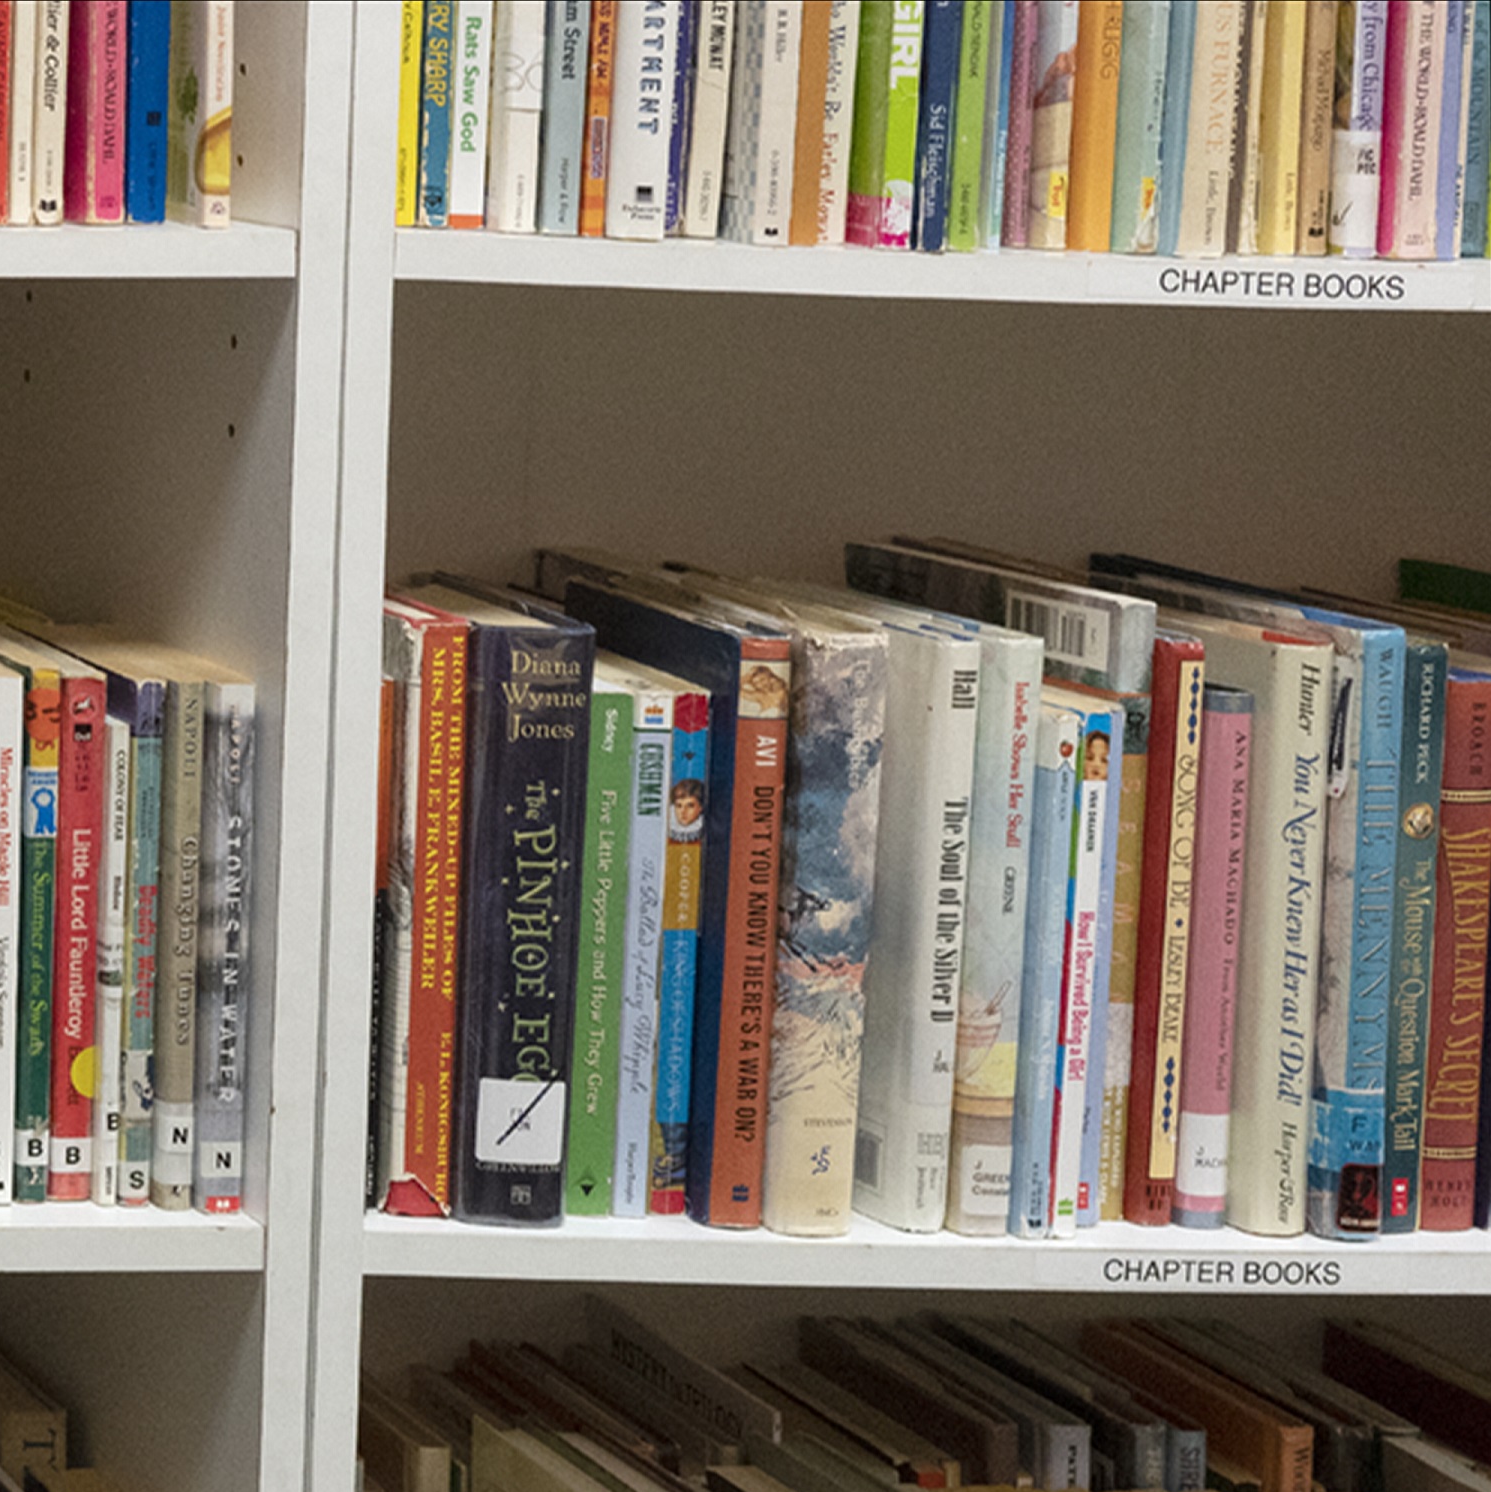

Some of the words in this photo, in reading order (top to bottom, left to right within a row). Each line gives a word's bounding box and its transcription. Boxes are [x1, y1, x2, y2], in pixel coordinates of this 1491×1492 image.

[464, 17, 482, 58] Rats
[462, 66, 480, 109] Saw
[460, 116, 478, 152] God
[1159, 267, 1294, 297] CHAPTER
[1303, 274, 1406, 300] BOOKS
[511, 651, 581, 673] Diana
[502, 684, 586, 706] Wynne
[1297, 663, 1320, 735] Hunter
[183, 699, 197, 778] NAPOLI
[508, 716, 573, 739] Jones
[754, 735, 778, 766] AVI
[637, 743, 665, 815] CUSHMAN
[1290, 753, 1319, 794] You
[749, 786, 775, 839] DON'T
[72, 829, 90, 877] Little
[1287, 800, 1317, 872] Never
[747, 844, 773, 884] YOU
[71, 886, 89, 929] Lord
[508, 828, 559, 1000] PINHOE
[744, 892, 770, 947] KNOW
[1283, 875, 1313, 946] Knew
[1443, 828, 1490, 1027] SHAKESPEARE'S
[65, 937, 88, 1038] Fauntleroy
[739, 953, 767, 1033] THERE'S
[1281, 950, 1309, 1001] Her
[1279, 1025, 1306, 1033] I
[1280, 1003, 1307, 1021] as
[738, 1038, 763, 1049] A
[736, 1055, 762, 1100] WAR
[1276, 1039, 1305, 1104] Did!
[1426, 1035, 1479, 1123] SECRET
[733, 1105, 760, 1142] ON?
[1103, 1258, 1234, 1283] CHAPTER
[1243, 1261, 1341, 1286] BOOKS
